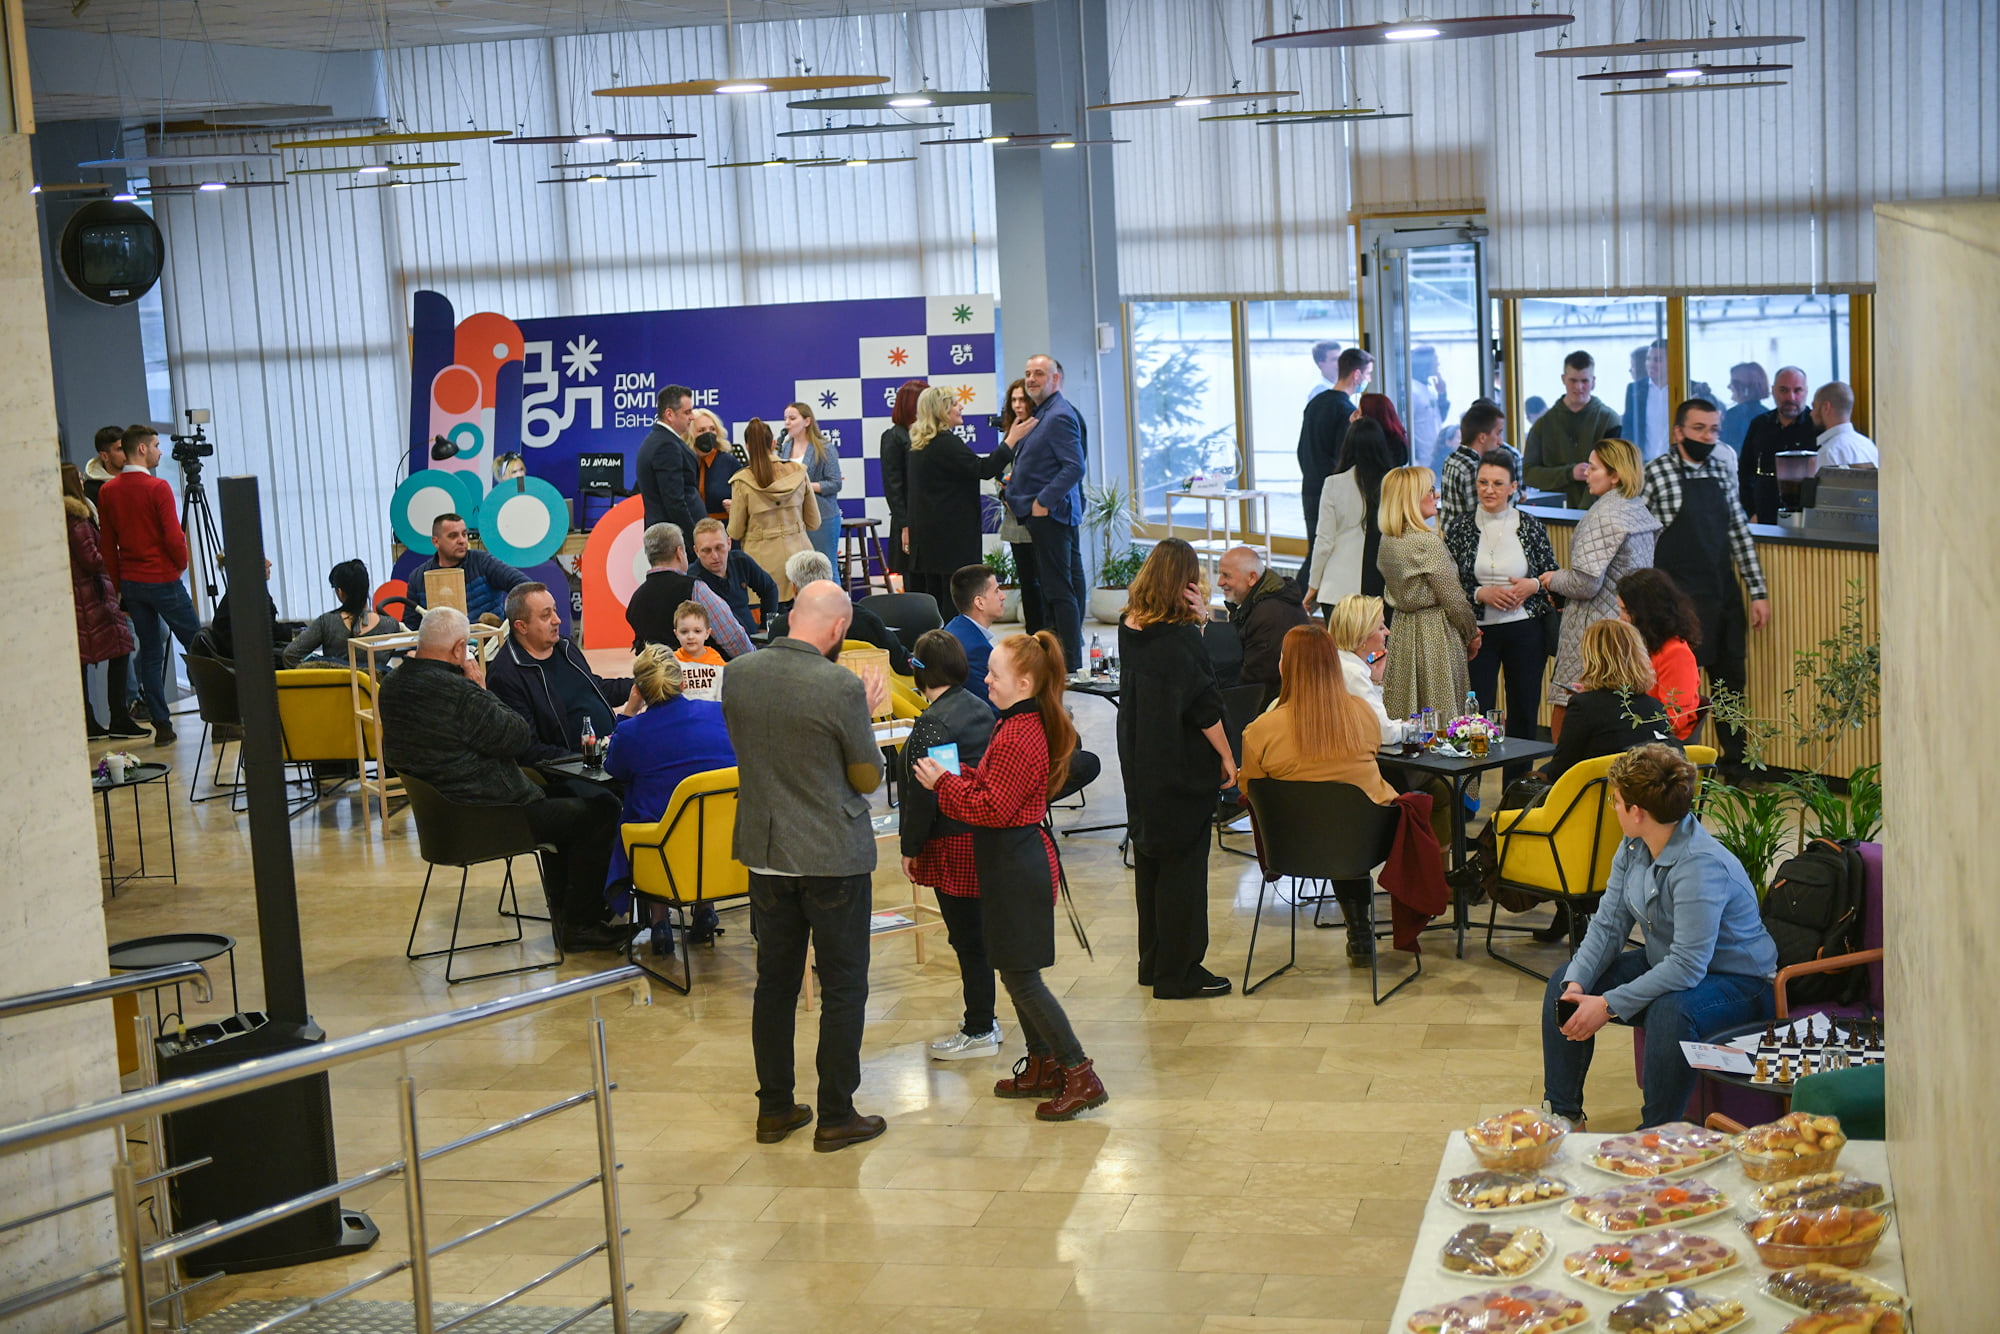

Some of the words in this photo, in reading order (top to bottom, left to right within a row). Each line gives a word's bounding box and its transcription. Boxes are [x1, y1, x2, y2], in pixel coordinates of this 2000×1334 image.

[614, 372, 655, 392] ДОМ
[614, 389, 719, 410] ОМЛНЕ
[580, 457, 591, 467] DJ
[592, 457, 621, 467] AVRAM
